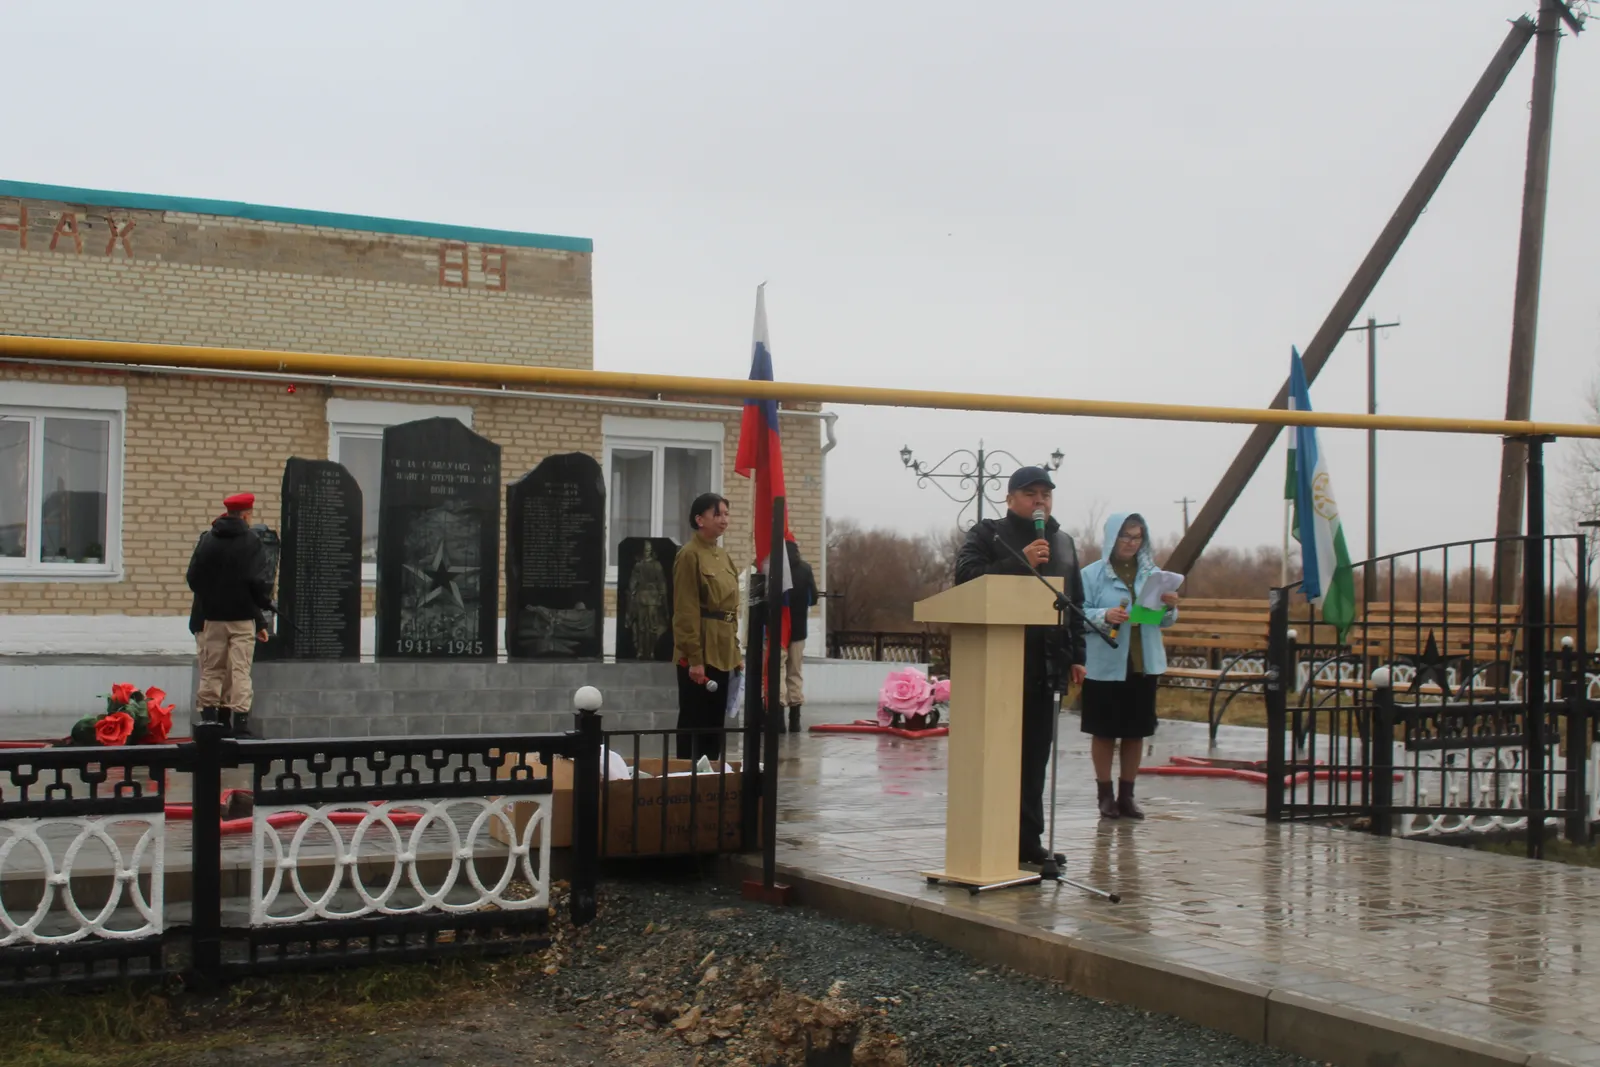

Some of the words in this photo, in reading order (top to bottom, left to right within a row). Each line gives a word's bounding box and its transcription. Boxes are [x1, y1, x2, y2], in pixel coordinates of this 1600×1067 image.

[439, 243, 507, 292] 89
[396, 639, 432, 653] 1941
[447, 640, 483, 654] 1945
